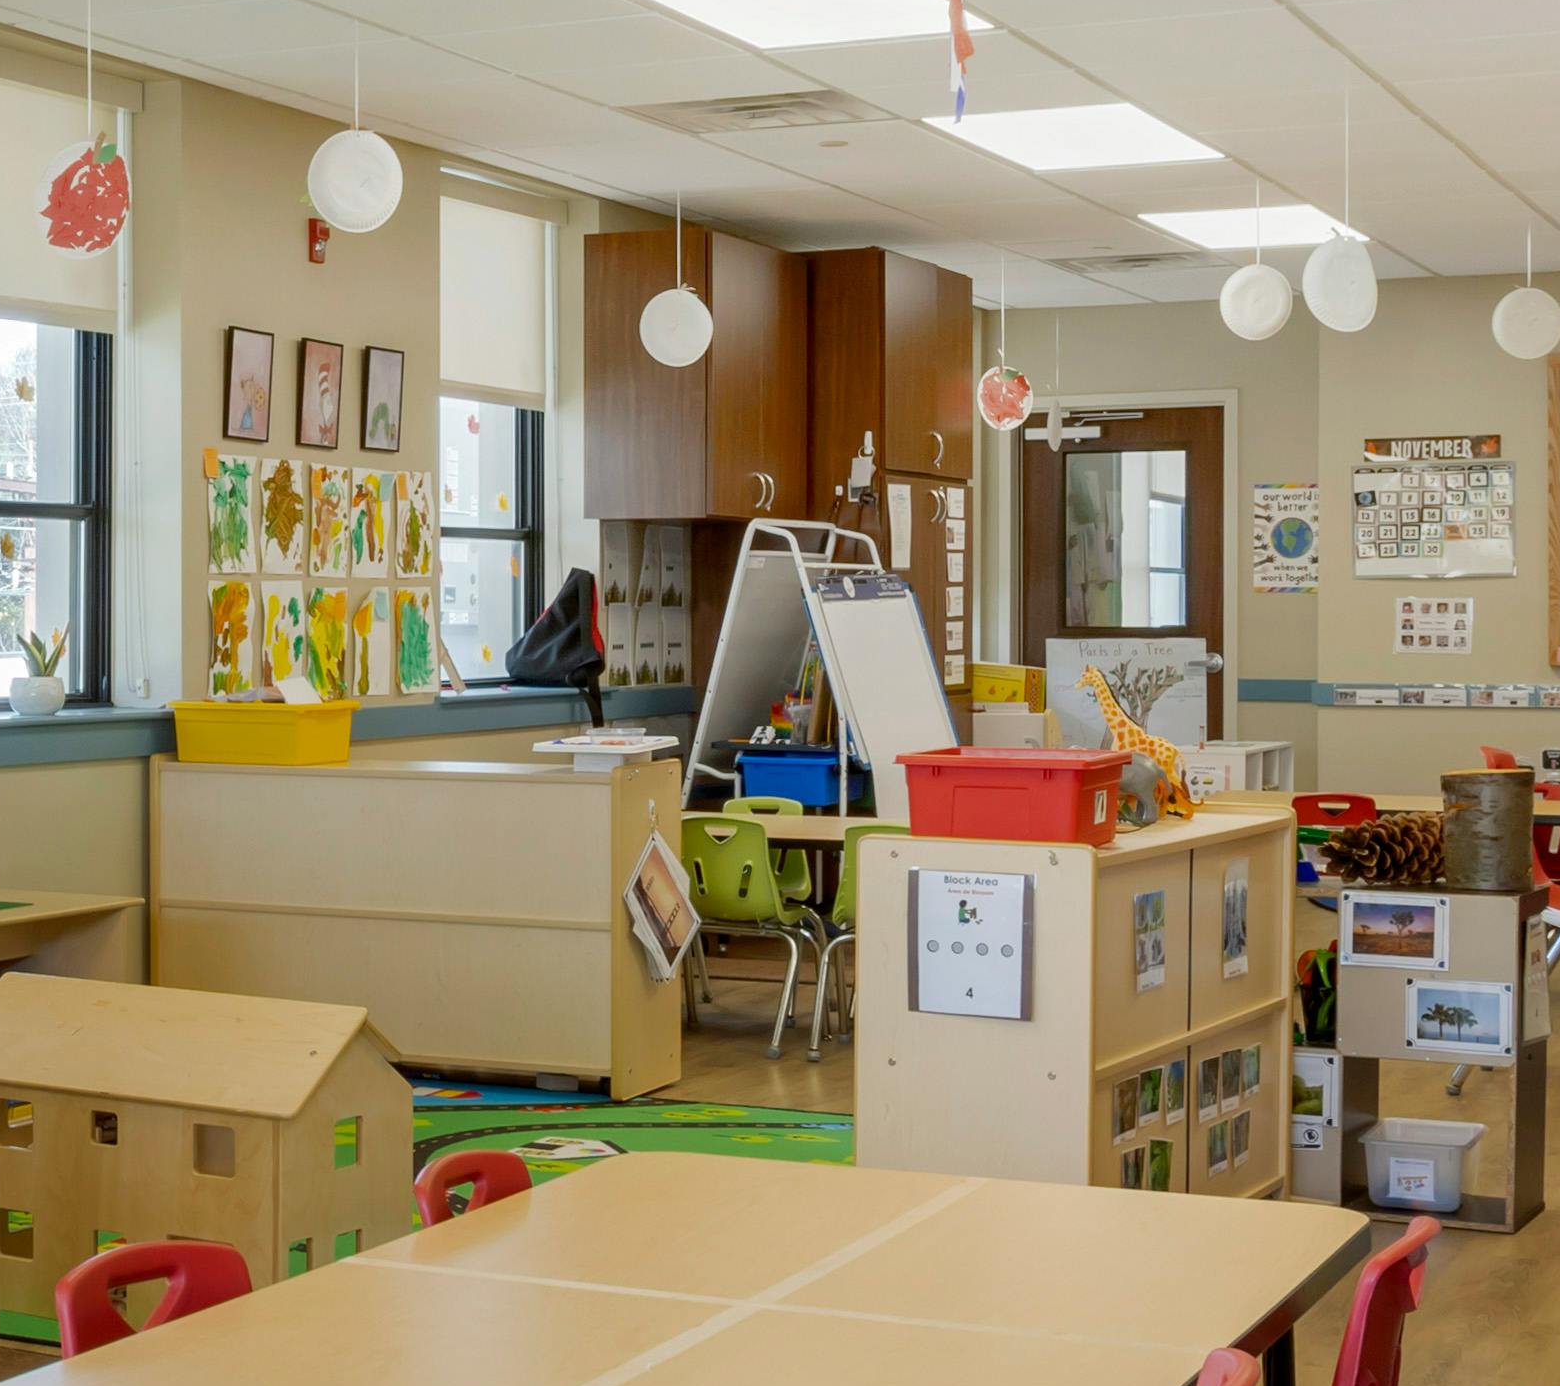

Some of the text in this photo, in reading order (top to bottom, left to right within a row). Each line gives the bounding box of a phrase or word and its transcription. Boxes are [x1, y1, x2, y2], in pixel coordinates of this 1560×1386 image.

[1390, 439, 1473, 459] NOVEMBER
[1262, 493, 1280, 501] our
[1282, 491, 1312, 501] world
[1277, 502, 1308, 512] better
[1273, 562, 1295, 571] when
[1260, 574, 1282, 582] work
[1080, 641, 1109, 658] Parts
[1145, 643, 1174, 656] Tree
[943, 875, 999, 886] Block Area
[965, 987, 974, 999] 4
